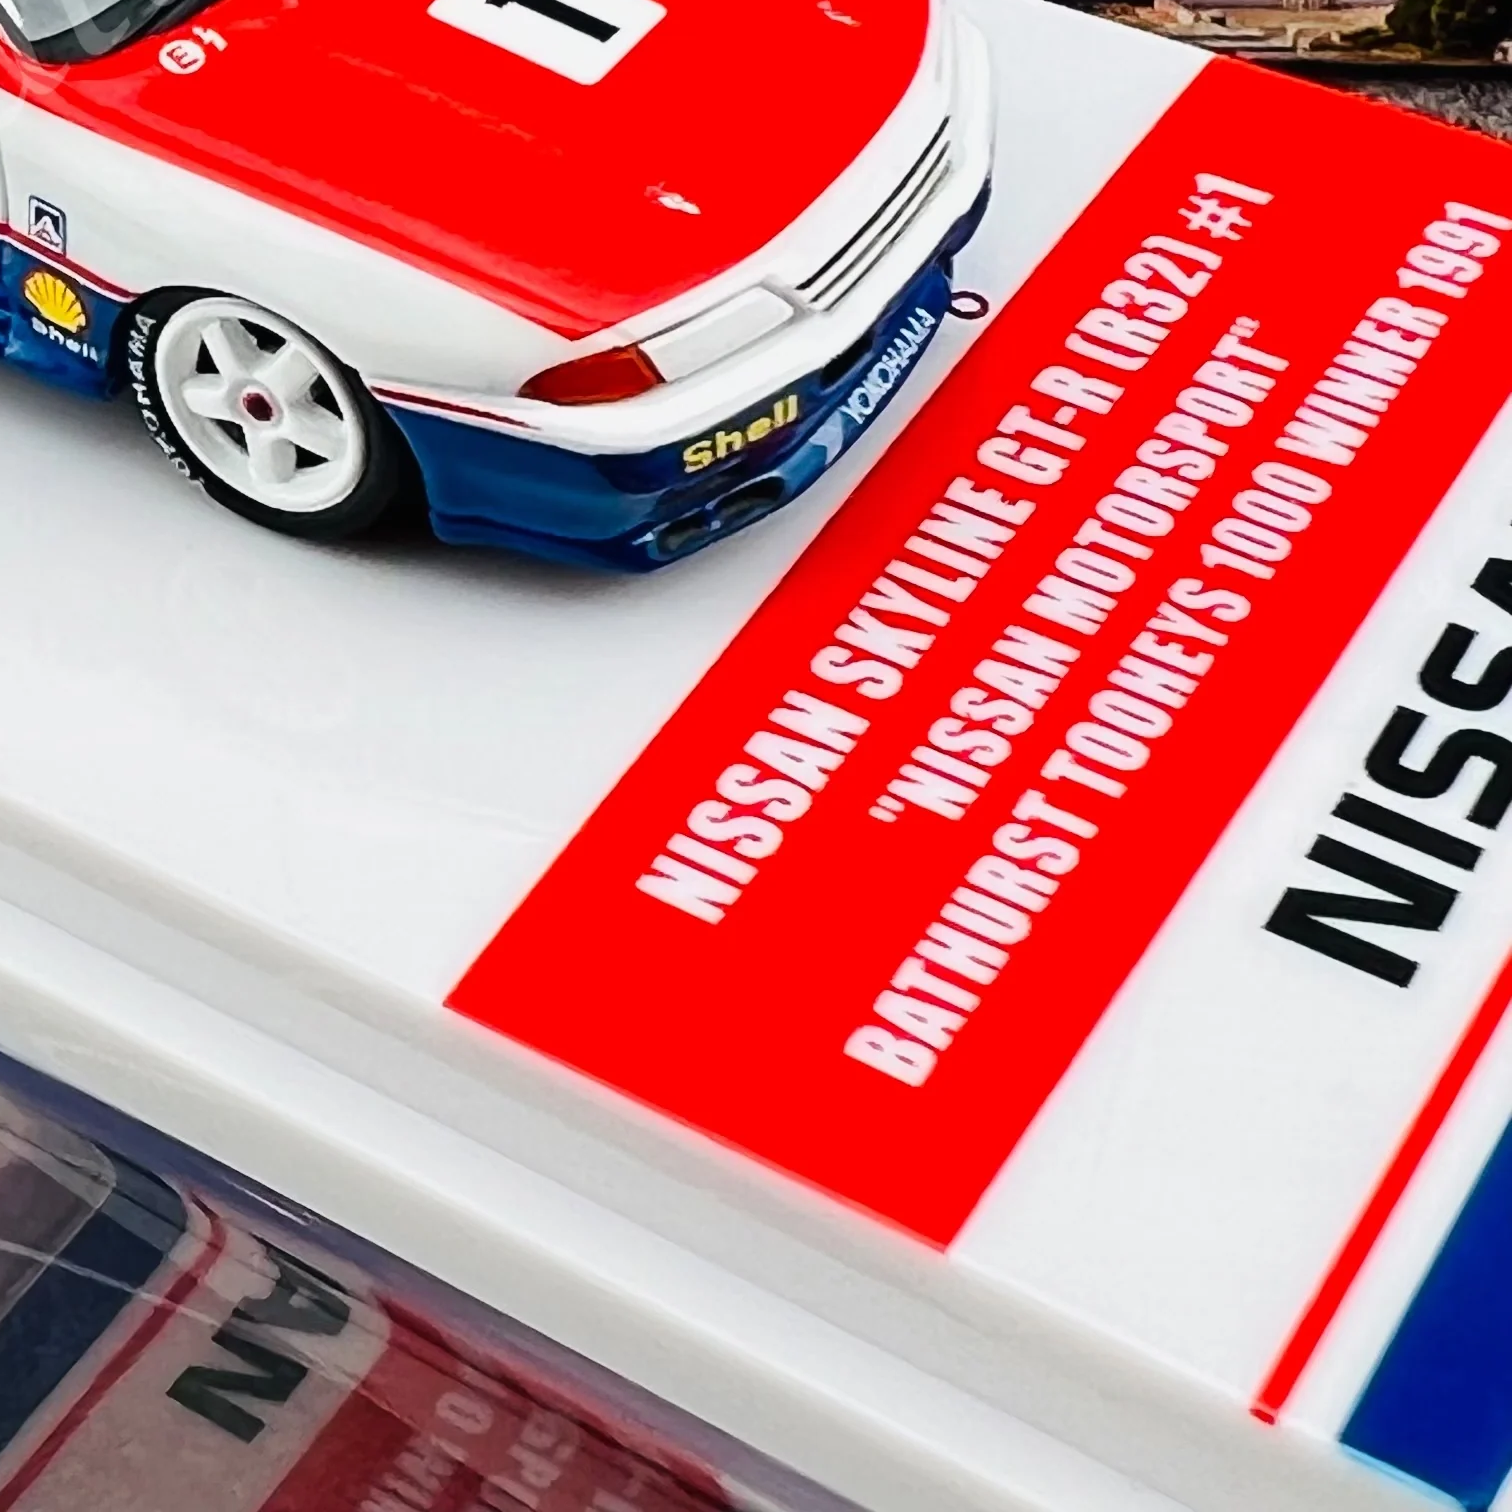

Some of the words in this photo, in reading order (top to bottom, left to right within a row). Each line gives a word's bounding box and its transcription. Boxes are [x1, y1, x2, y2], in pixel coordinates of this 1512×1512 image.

[31, 317, 99, 362] Shell
[635, 690, 871, 926] NISSAN
[809, 476, 1037, 700] SKYLINE
[976, 365, 1126, 486] GT-R
[1065, 235, 1223, 372] (R32)
[1177, 172, 1275, 241] #1
[682, 395, 798, 474] Shell
[868, 625, 1081, 823] "NISSAN
[1022, 316, 1291, 636] MOTORSPORT"
[843, 788, 1100, 1088] BATHURST
[1040, 577, 1252, 800] TOOHEYS
[1199, 461, 1333, 580] 1000
[1274, 296, 1449, 467] WINNER
[1396, 201, 1512, 299] 1991
[1261, 516, 1512, 988] NISS
